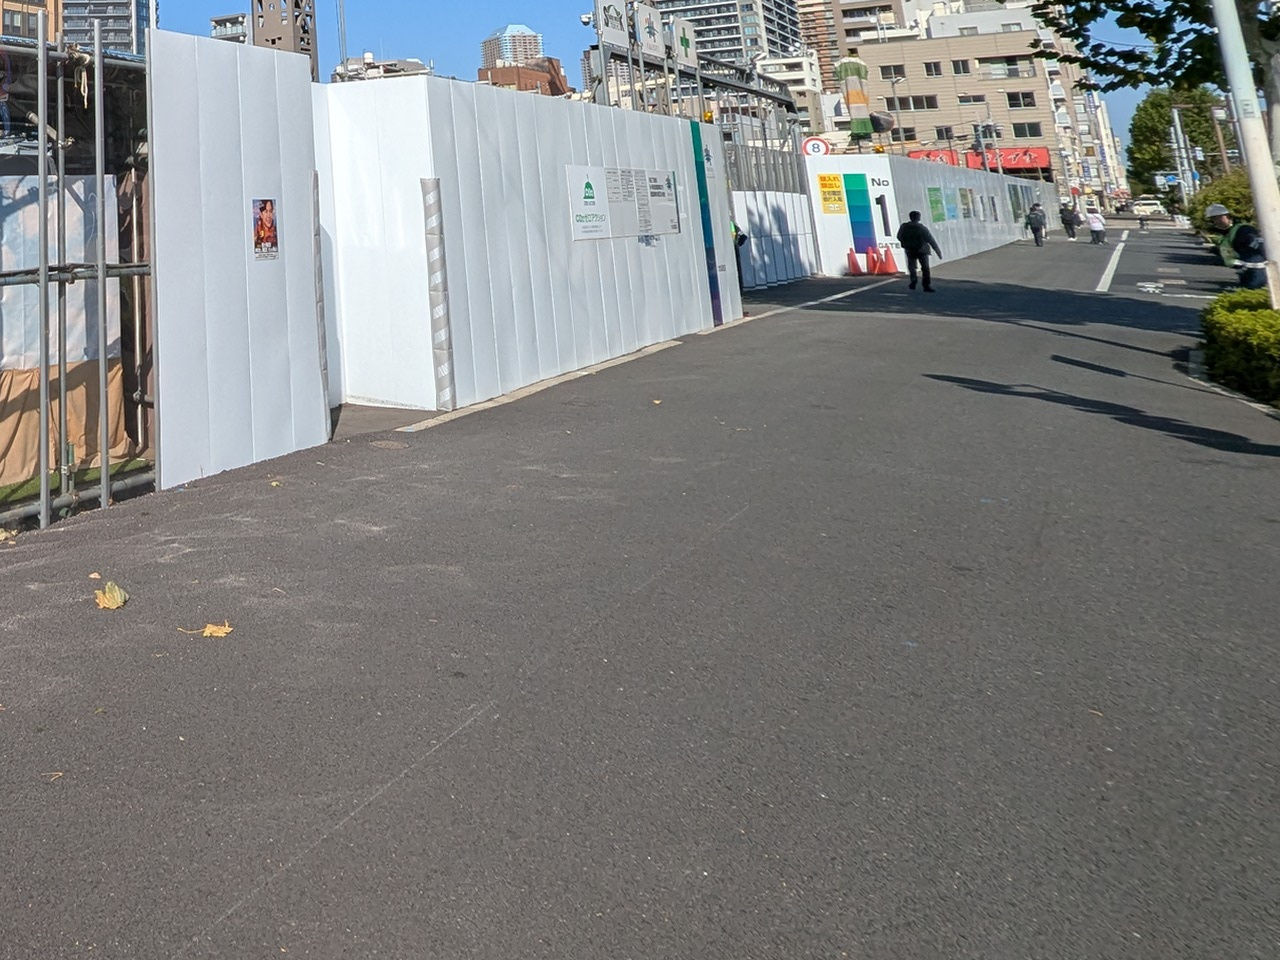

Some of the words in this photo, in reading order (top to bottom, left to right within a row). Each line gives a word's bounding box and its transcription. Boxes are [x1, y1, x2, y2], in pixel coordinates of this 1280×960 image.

[811, 143, 821, 153] 8
[871, 178, 890, 187] No
[875, 194, 892, 237] 1
